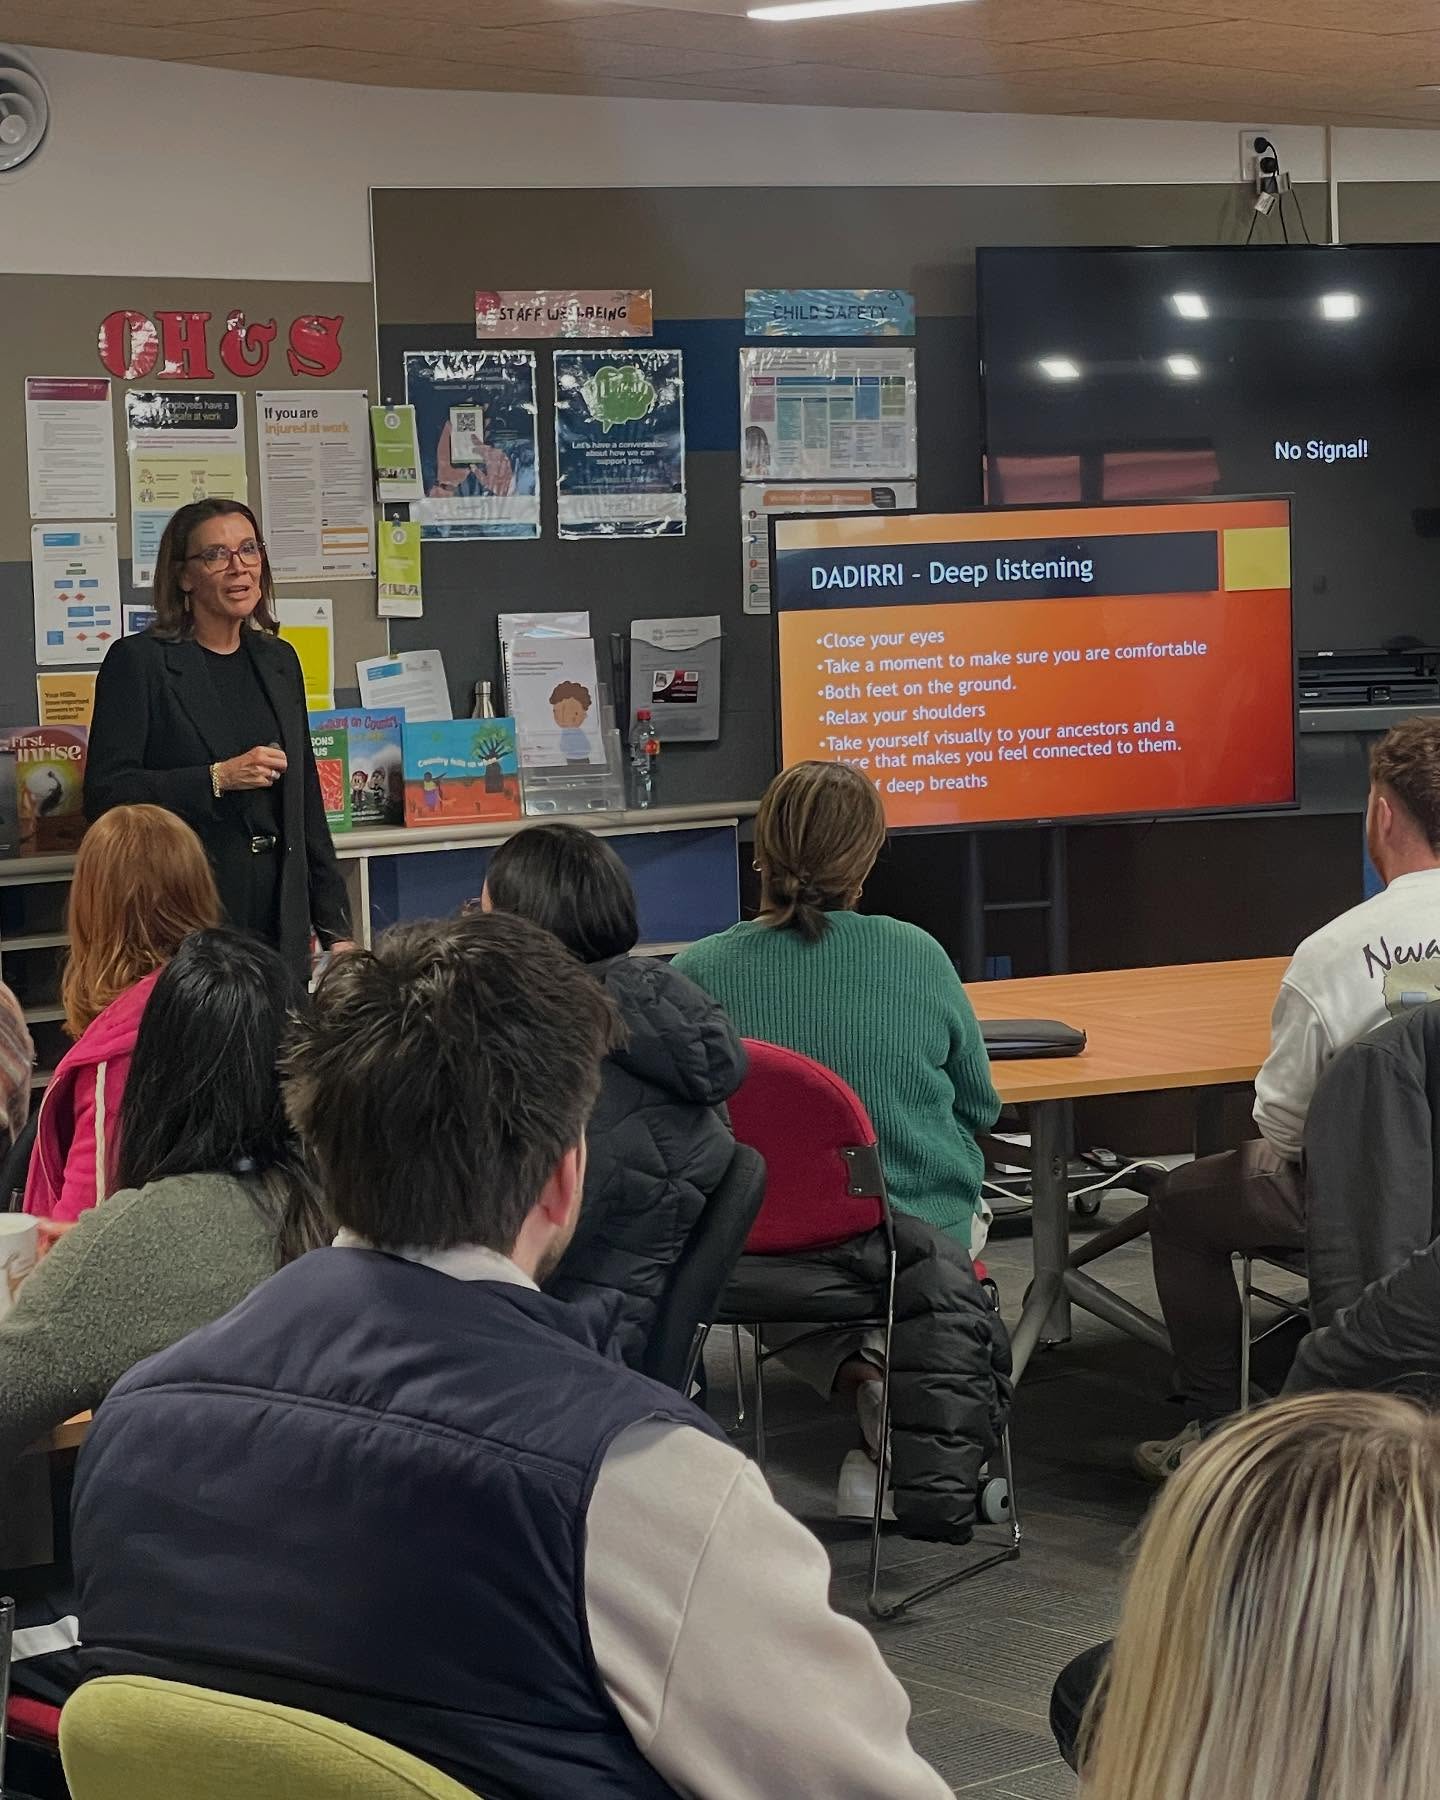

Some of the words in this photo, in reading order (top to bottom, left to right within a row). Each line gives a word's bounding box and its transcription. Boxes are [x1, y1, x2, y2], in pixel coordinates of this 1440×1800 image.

[499, 307, 543, 322] STAFF
[773, 305, 819, 320] CHILD
[824, 305, 888, 320] SAFETY
[265, 408, 273, 419] If
[275, 409, 297, 421] you
[299, 409, 318, 419] are
[310, 423, 320, 433] at
[322, 421, 349, 433] work
[1275, 441, 1301, 460] No
[1306, 439, 1368, 463] Signal!
[596, 458, 627, 466] support
[811, 563, 904, 590] DADIRRI
[929, 561, 989, 588] Deep
[995, 556, 1095, 582] listening
[823, 633, 865, 649] Close
[870, 632, 905, 650] your
[910, 631, 945, 647] eyes
[824, 658, 860, 674] Take
[865, 660, 875, 672] a
[880, 655, 943, 671] moment
[949, 654, 965, 668] to
[970, 651, 1012, 666] make
[1016, 651, 1048, 665] sure
[1053, 650, 1080, 665] you
[1085, 648, 1110, 661] are
[1115, 640, 1207, 659] comfortable
[825, 684, 861, 700] Both
[866, 682, 899, 698] feet
[903, 683, 922, 696] on
[928, 678, 953, 694] the
[958, 675, 1017, 696] ground.
[826, 710, 868, 725] Relax
[873, 708, 907, 726] your
[912, 703, 986, 720] shoulders
[11, 735, 45, 748] First
[826, 736, 862, 751] Take
[867, 730, 930, 751] yourself
[934, 727, 992, 746] visually
[997, 728, 1013, 741] to
[1018, 727, 1051, 744] your
[1056, 721, 1128, 739] ancestors
[1133, 716, 1160, 734] and
[1165, 720, 1175, 732] a
[875, 753, 906, 769] that
[912, 751, 961, 767] makes
[965, 750, 993, 767] you
[998, 746, 1028, 761] feel
[1032, 740, 1112, 759] connected
[1117, 740, 1133, 754] to
[1138, 737, 1182, 753] them.
[886, 776, 925, 795] deep
[930, 774, 988, 792] breaths
